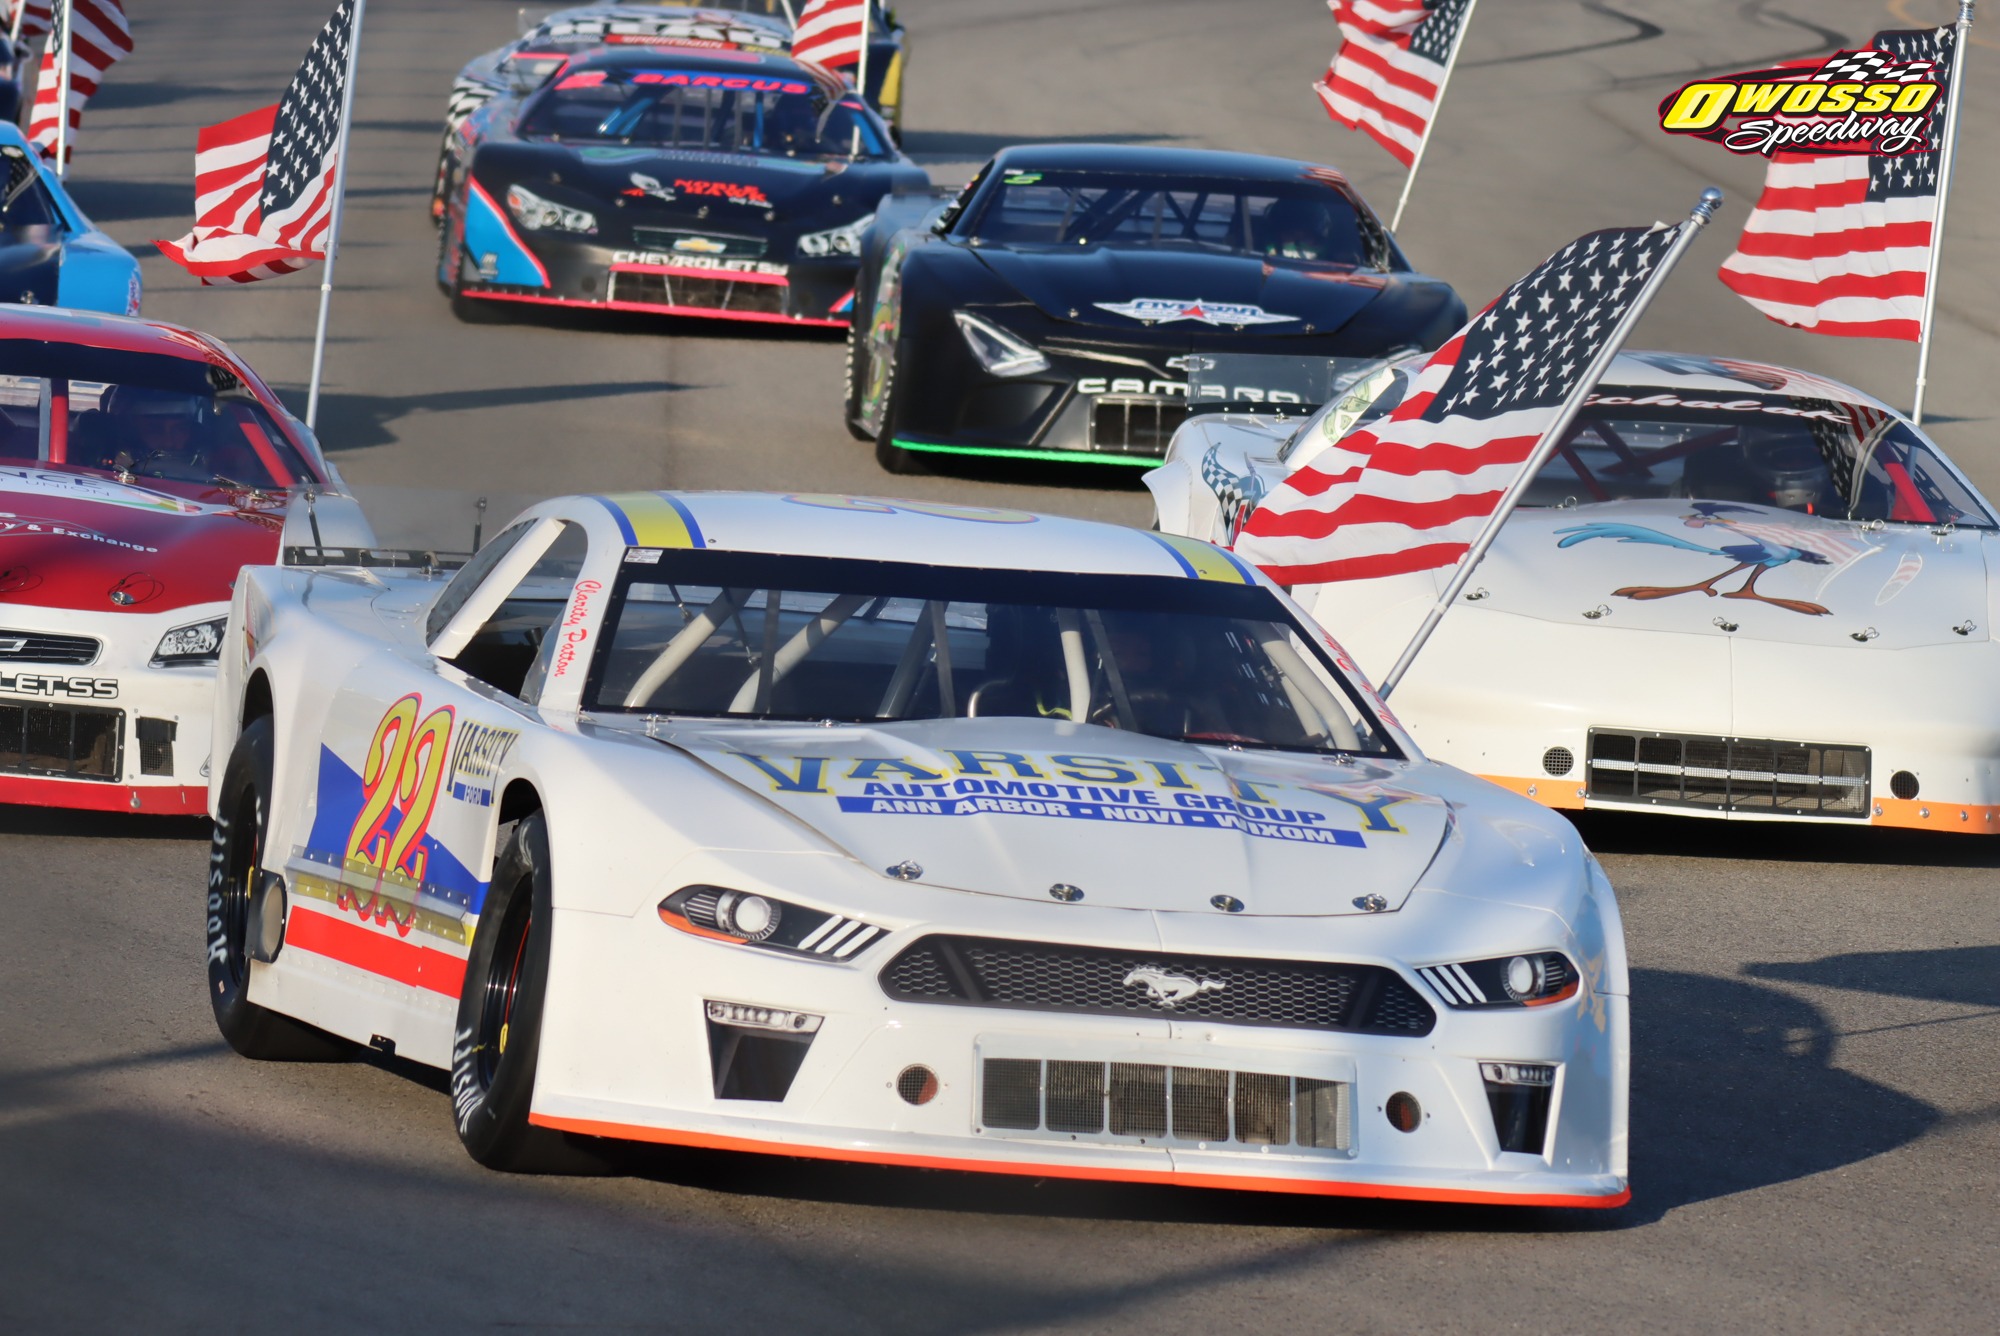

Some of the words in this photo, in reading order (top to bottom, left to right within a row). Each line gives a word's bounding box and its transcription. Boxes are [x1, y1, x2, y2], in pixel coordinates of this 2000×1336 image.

[631, 73, 809, 94] BARCUS
[1077, 378, 1300, 404] CAMARO
[52, 527, 159, 553] Exchange
[553, 628, 588, 678] Patton
[446, 718, 521, 805] VARSITY
[464, 785, 482, 805] FORD
[725, 749, 1412, 834] VARSITY
[863, 778, 1160, 806] AUTOMOTIVE
[1175, 793, 1327, 825] GROUP
[337, 692, 456, 938] 22
[872, 800, 942, 814] ANN
[953, 798, 1071, 817] ARBOR
[1104, 806, 1183, 824] NOVI
[1211, 814, 1337, 844] WIXOM
